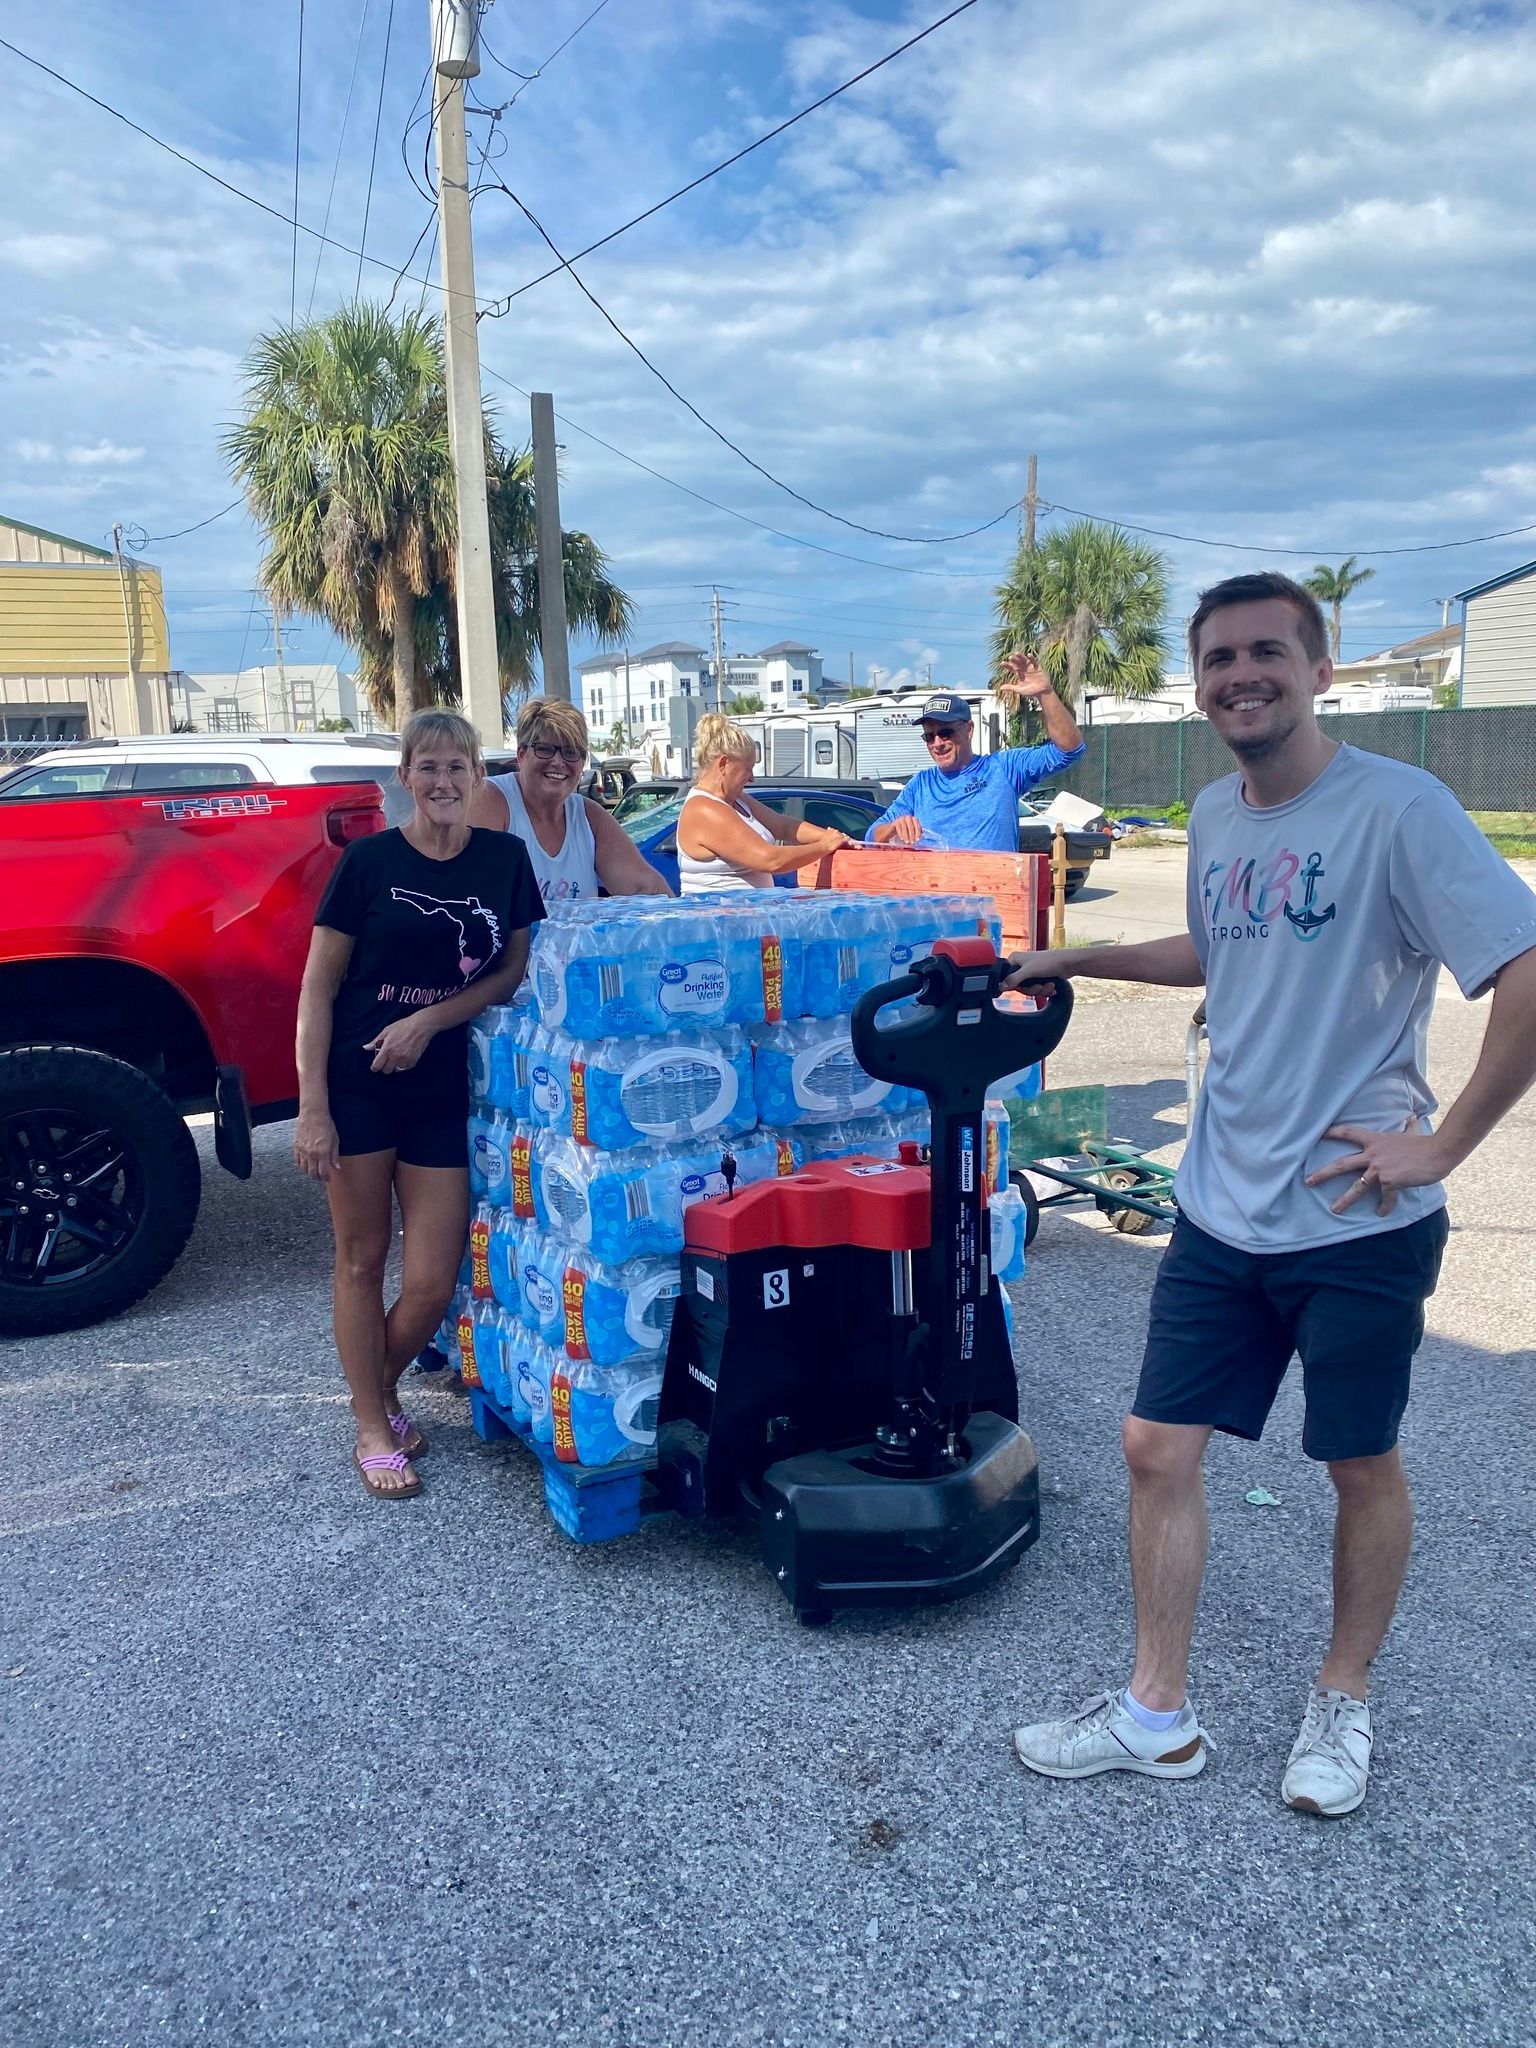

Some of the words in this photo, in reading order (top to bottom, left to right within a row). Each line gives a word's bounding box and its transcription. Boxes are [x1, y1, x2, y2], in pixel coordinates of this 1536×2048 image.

[142, 794, 287, 812] TRAIL
[1211, 924, 1270, 941] TRONG
[764, 946, 781, 961] 40
[661, 968, 682, 977] Great
[684, 982, 724, 993] Drinking
[696, 990, 724, 1001] Water
[576, 1102, 585, 1137] VALUE
[512, 1147, 530, 1162] 40
[779, 1151, 792, 1165] 40
[513, 1174, 523, 1205] PACK
[520, 1175, 532, 1206] VALUE
[683, 1178, 701, 1188] Great
[471, 1232, 488, 1247] 40
[472, 1258, 481, 1288] PACK
[479, 1259, 490, 1289] VALUE
[563, 1280, 583, 1297] 40
[457, 1325, 472, 1339] 40
[565, 1309, 576, 1344] PACK
[572, 1311, 586, 1346] VALUE
[461, 1351, 470, 1380] PACK
[468, 1352, 479, 1379] VALUE
[689, 1363, 717, 1392] HANGC
[552, 1386, 570, 1403] 40
[554, 1415, 564, 1448] PACK
[561, 1417, 574, 1449] VALUE
